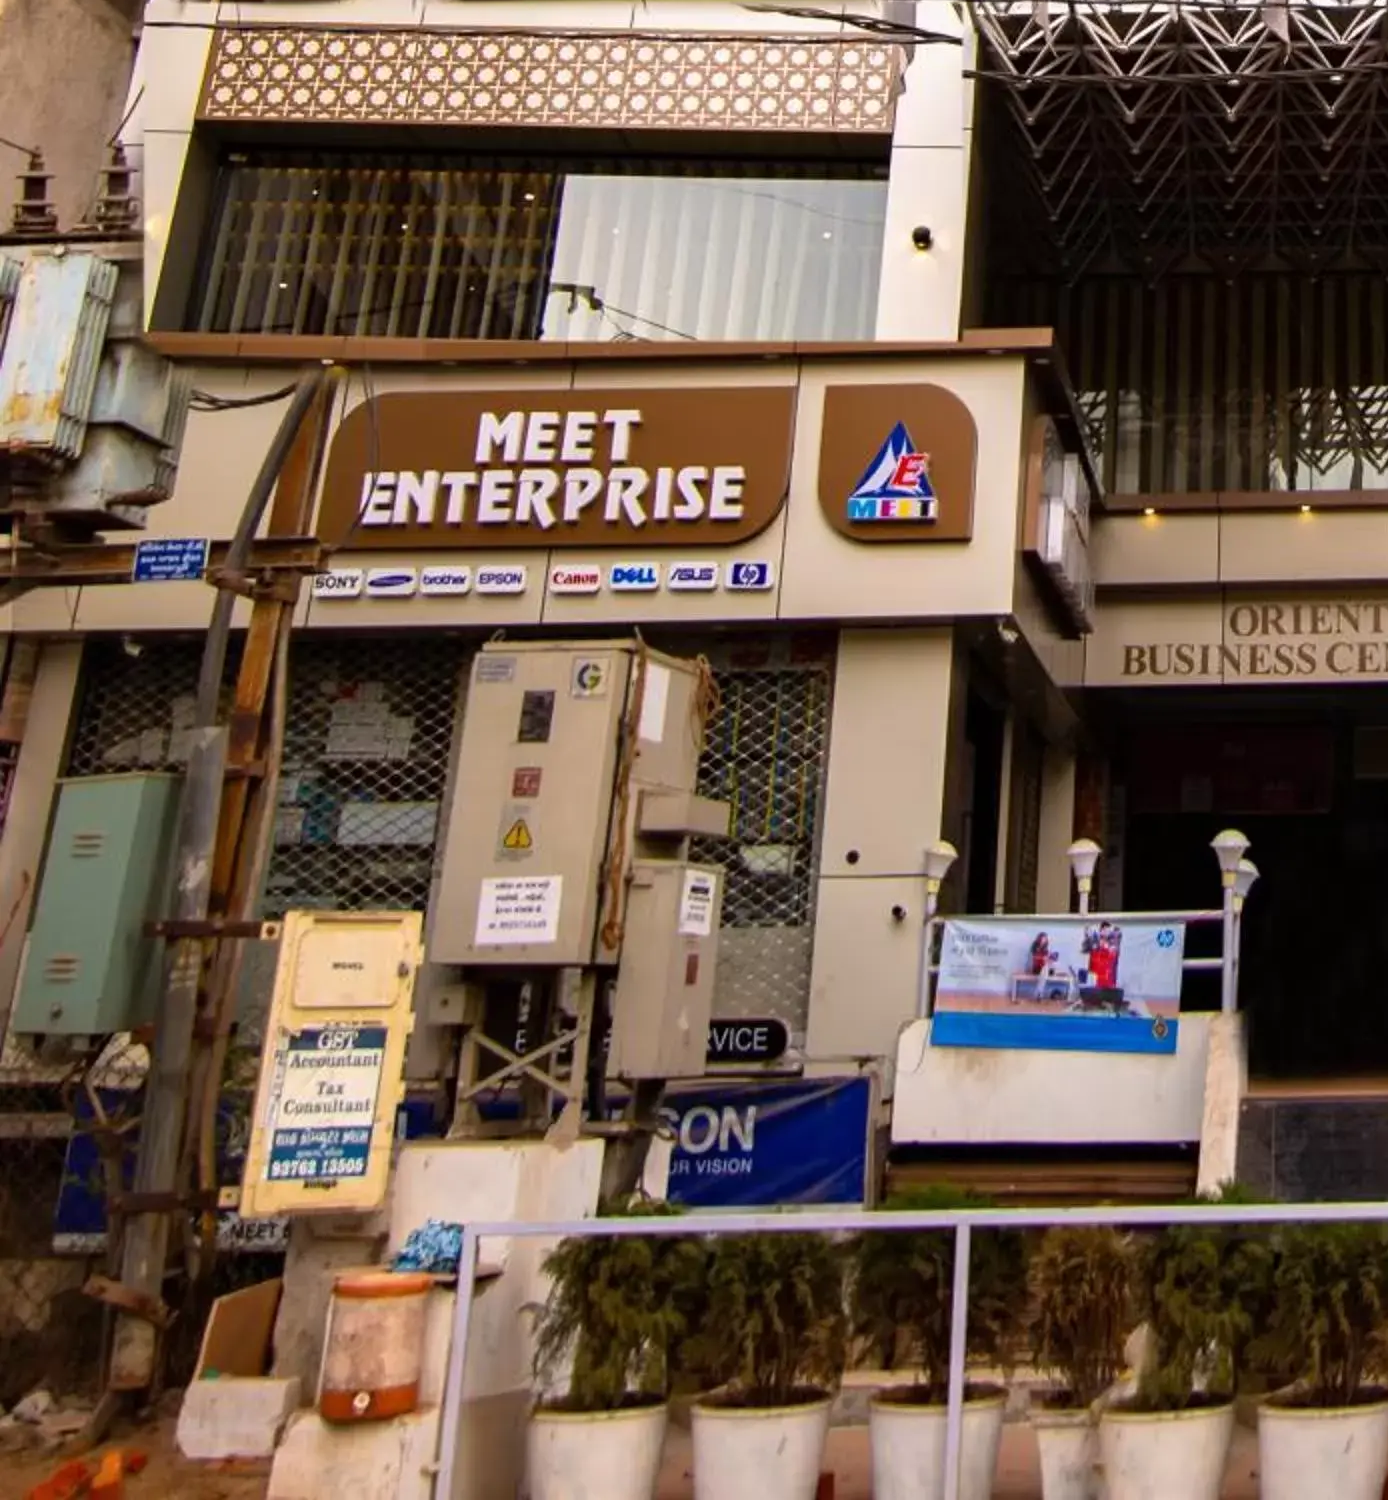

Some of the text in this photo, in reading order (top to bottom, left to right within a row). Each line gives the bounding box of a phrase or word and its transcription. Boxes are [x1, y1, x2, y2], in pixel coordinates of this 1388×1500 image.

[475, 409, 643, 464] MEET
[361, 466, 746, 530] ENTERPRISE
[315, 575, 359, 590] SONY
[422, 572, 466, 586] brother
[478, 572, 523, 585] EPSON
[552, 570, 599, 585] Canon
[611, 567, 657, 583] DELL
[670, 567, 715, 582] ASUS
[1121, 643, 1318, 676] BUSINESS
[317, 1030, 359, 1050] GST
[289, 1052, 379, 1069] Accountant
[316, 1080, 345, 1095] Tax
[283, 1099, 371, 1116] Consultant
[696, 1157, 753, 1174] VISION
